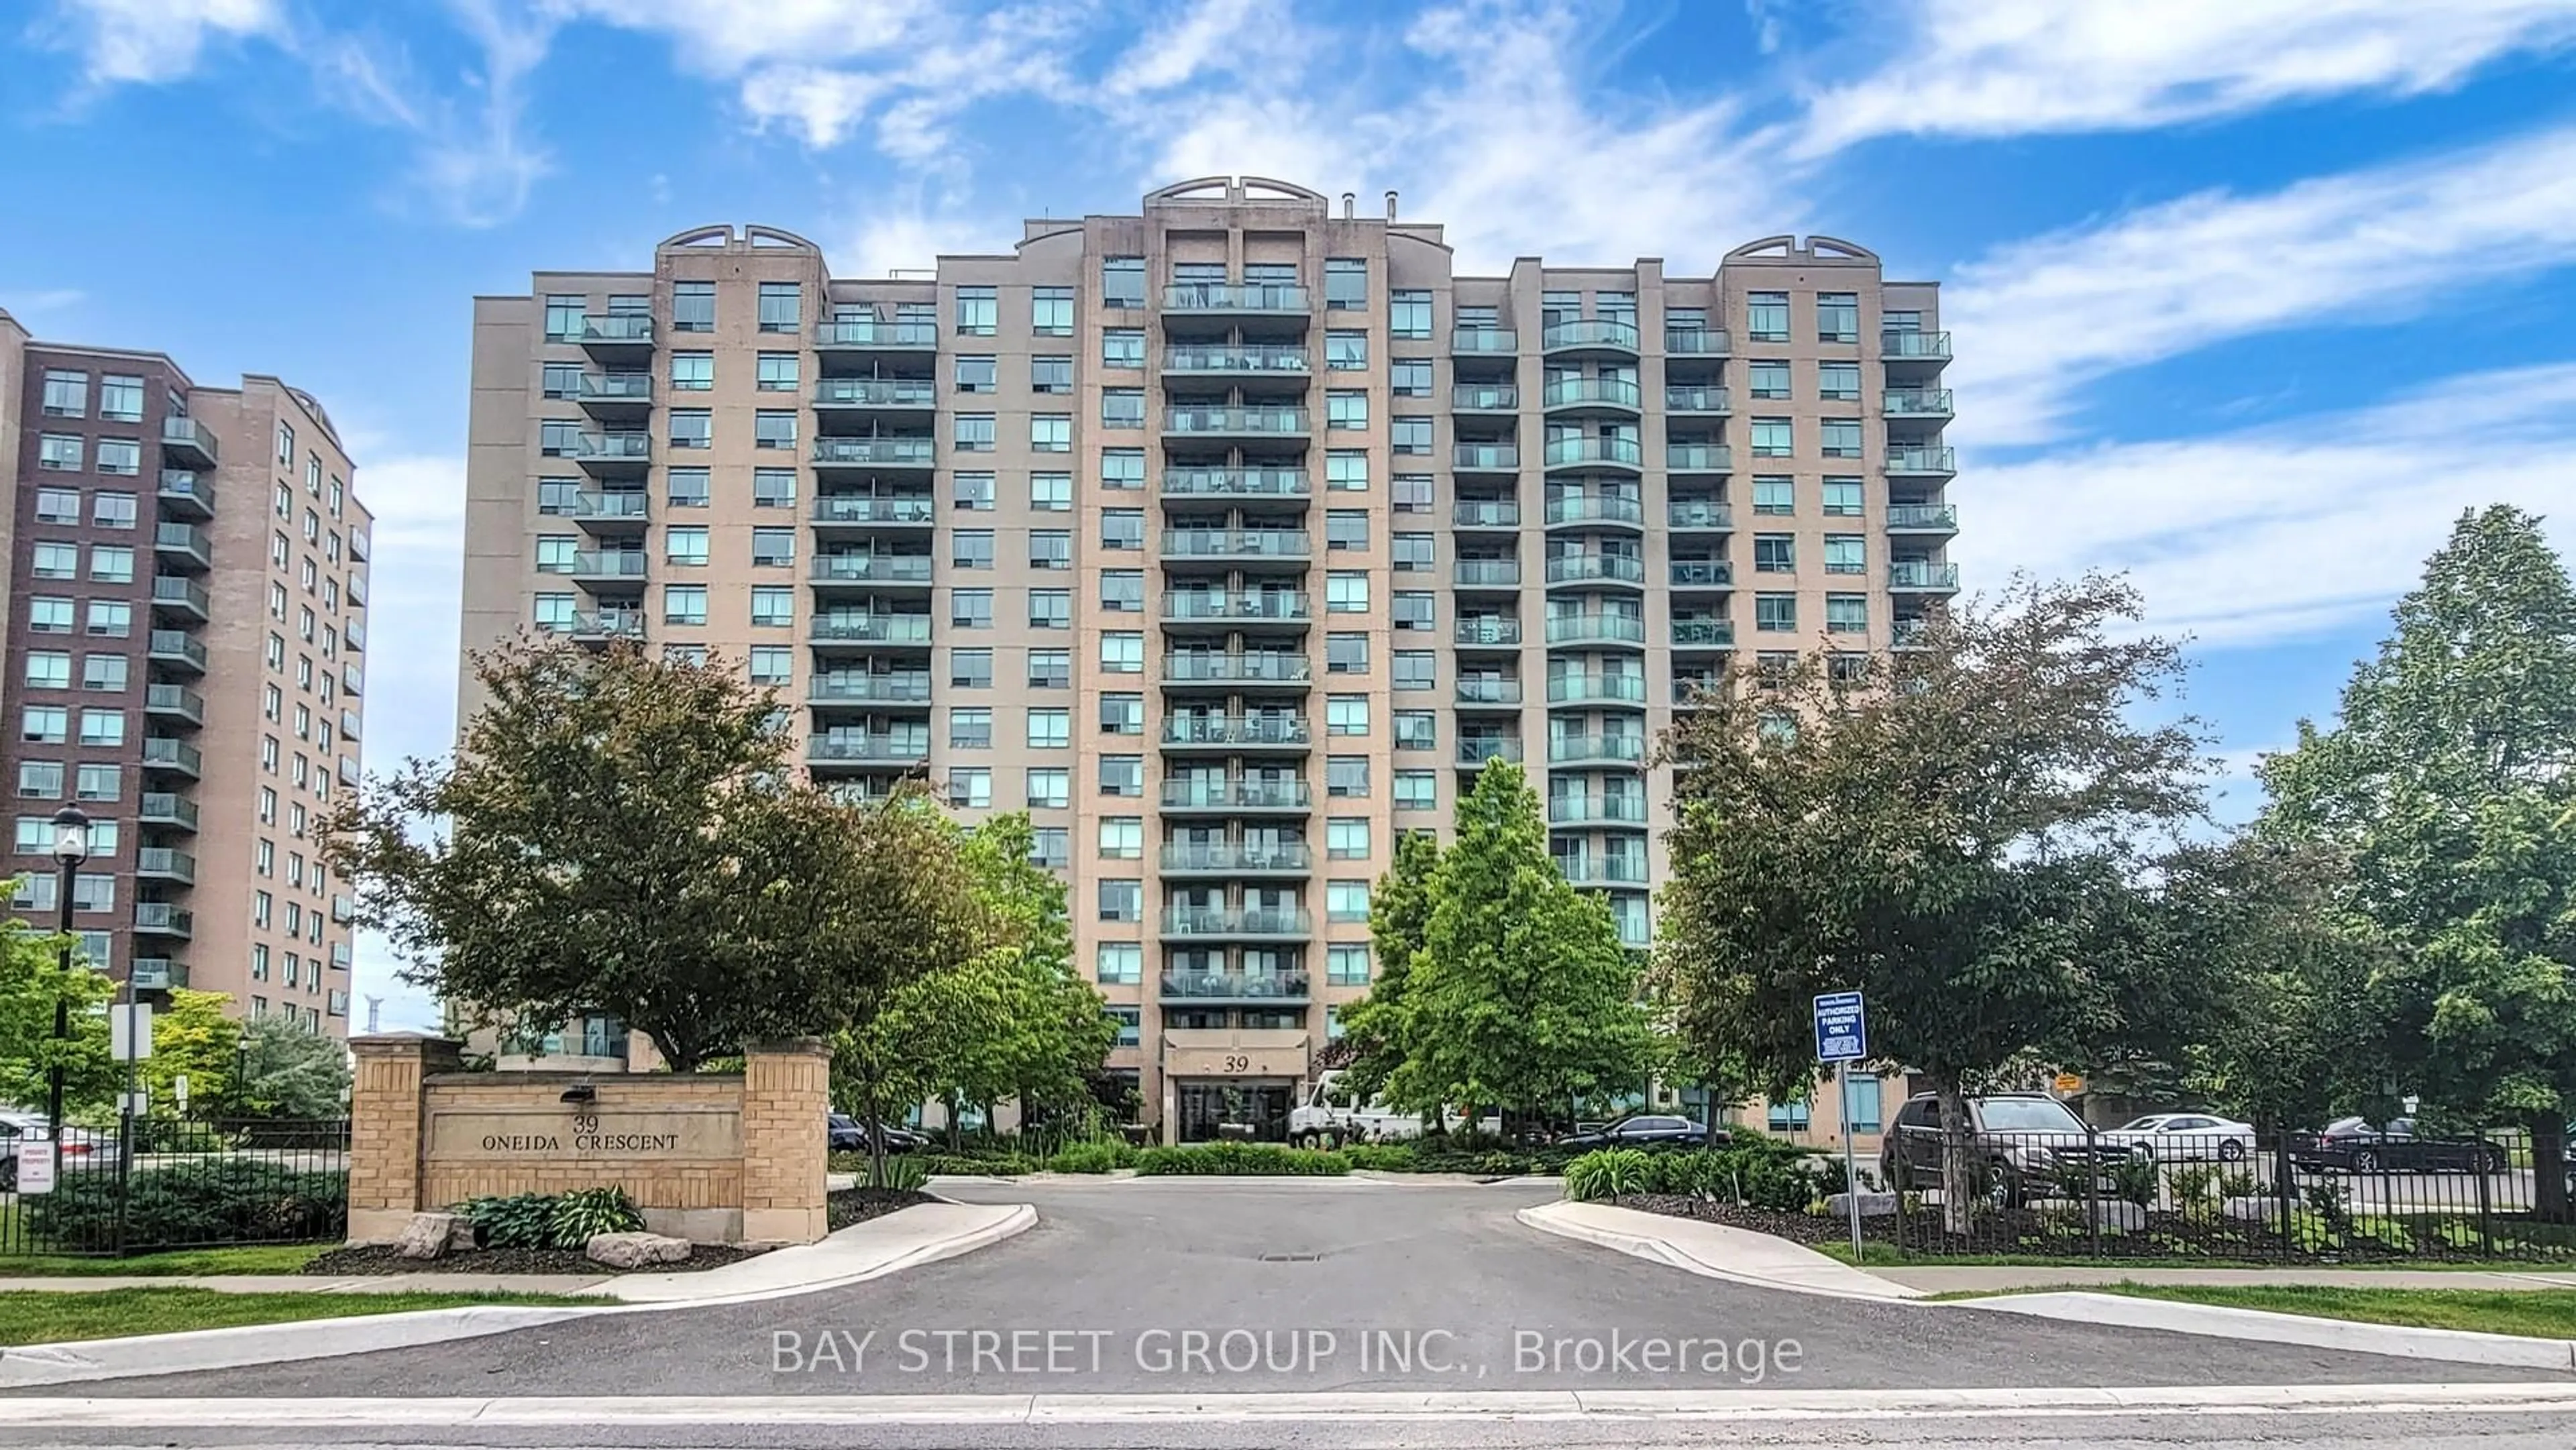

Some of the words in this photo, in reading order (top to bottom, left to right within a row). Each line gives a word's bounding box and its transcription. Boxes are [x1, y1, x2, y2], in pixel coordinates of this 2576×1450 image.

[1818, 1005, 1860, 1017] AUTHORIZED
[1822, 1015, 1856, 1026] PARKING
[1829, 1025, 1850, 1035] ONLY
[1224, 1056, 1248, 1072] 39
[574, 1115, 598, 1133] 39
[482, 1135, 559, 1150] ONEIDA
[575, 1134, 679, 1150] CRESCENT
